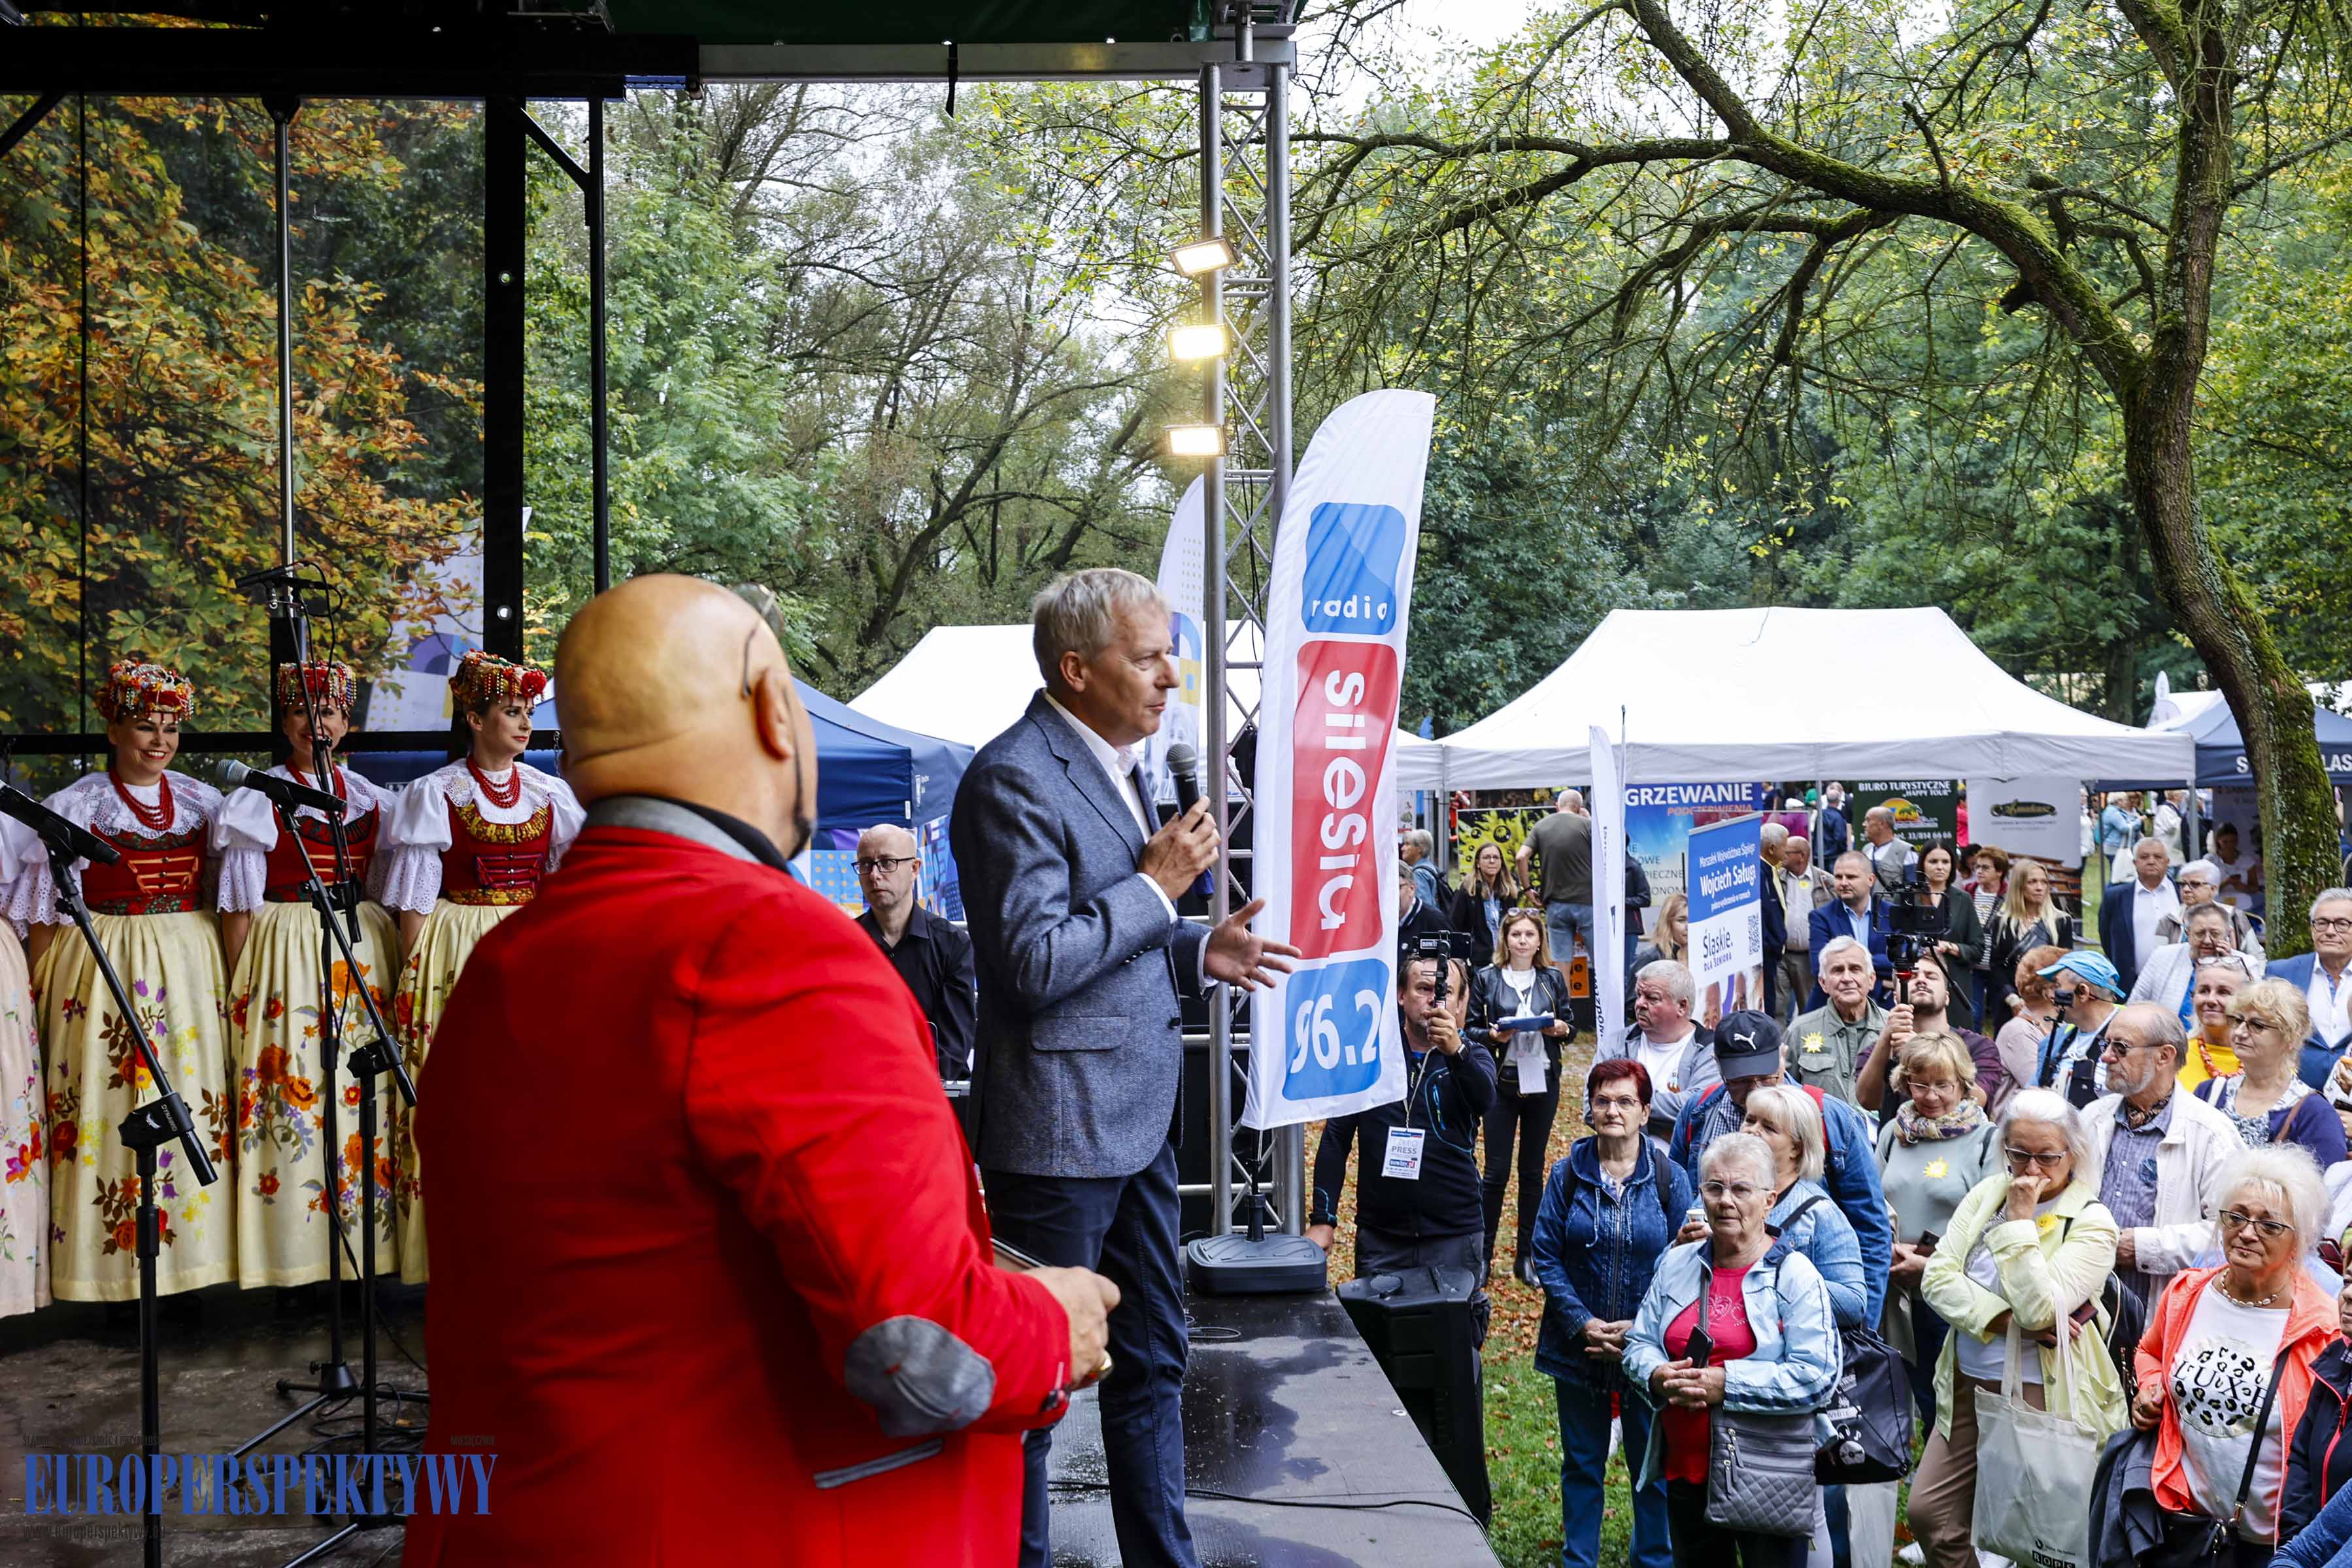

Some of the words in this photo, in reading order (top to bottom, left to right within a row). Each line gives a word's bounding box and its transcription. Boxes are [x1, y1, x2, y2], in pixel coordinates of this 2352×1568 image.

[1311, 595, 1387, 620] radio
[1624, 784, 1753, 806] GRZEWANIE
[1858, 782, 1888, 791] BIURO
[1889, 781, 1951, 790] TURYSTYCZNE
[1644, 869, 1685, 879] PIECZNE
[1700, 867, 1732, 899] Wojciech
[1290, 989, 1383, 1074] 96.2
[1391, 1145, 1417, 1155] PRESS
